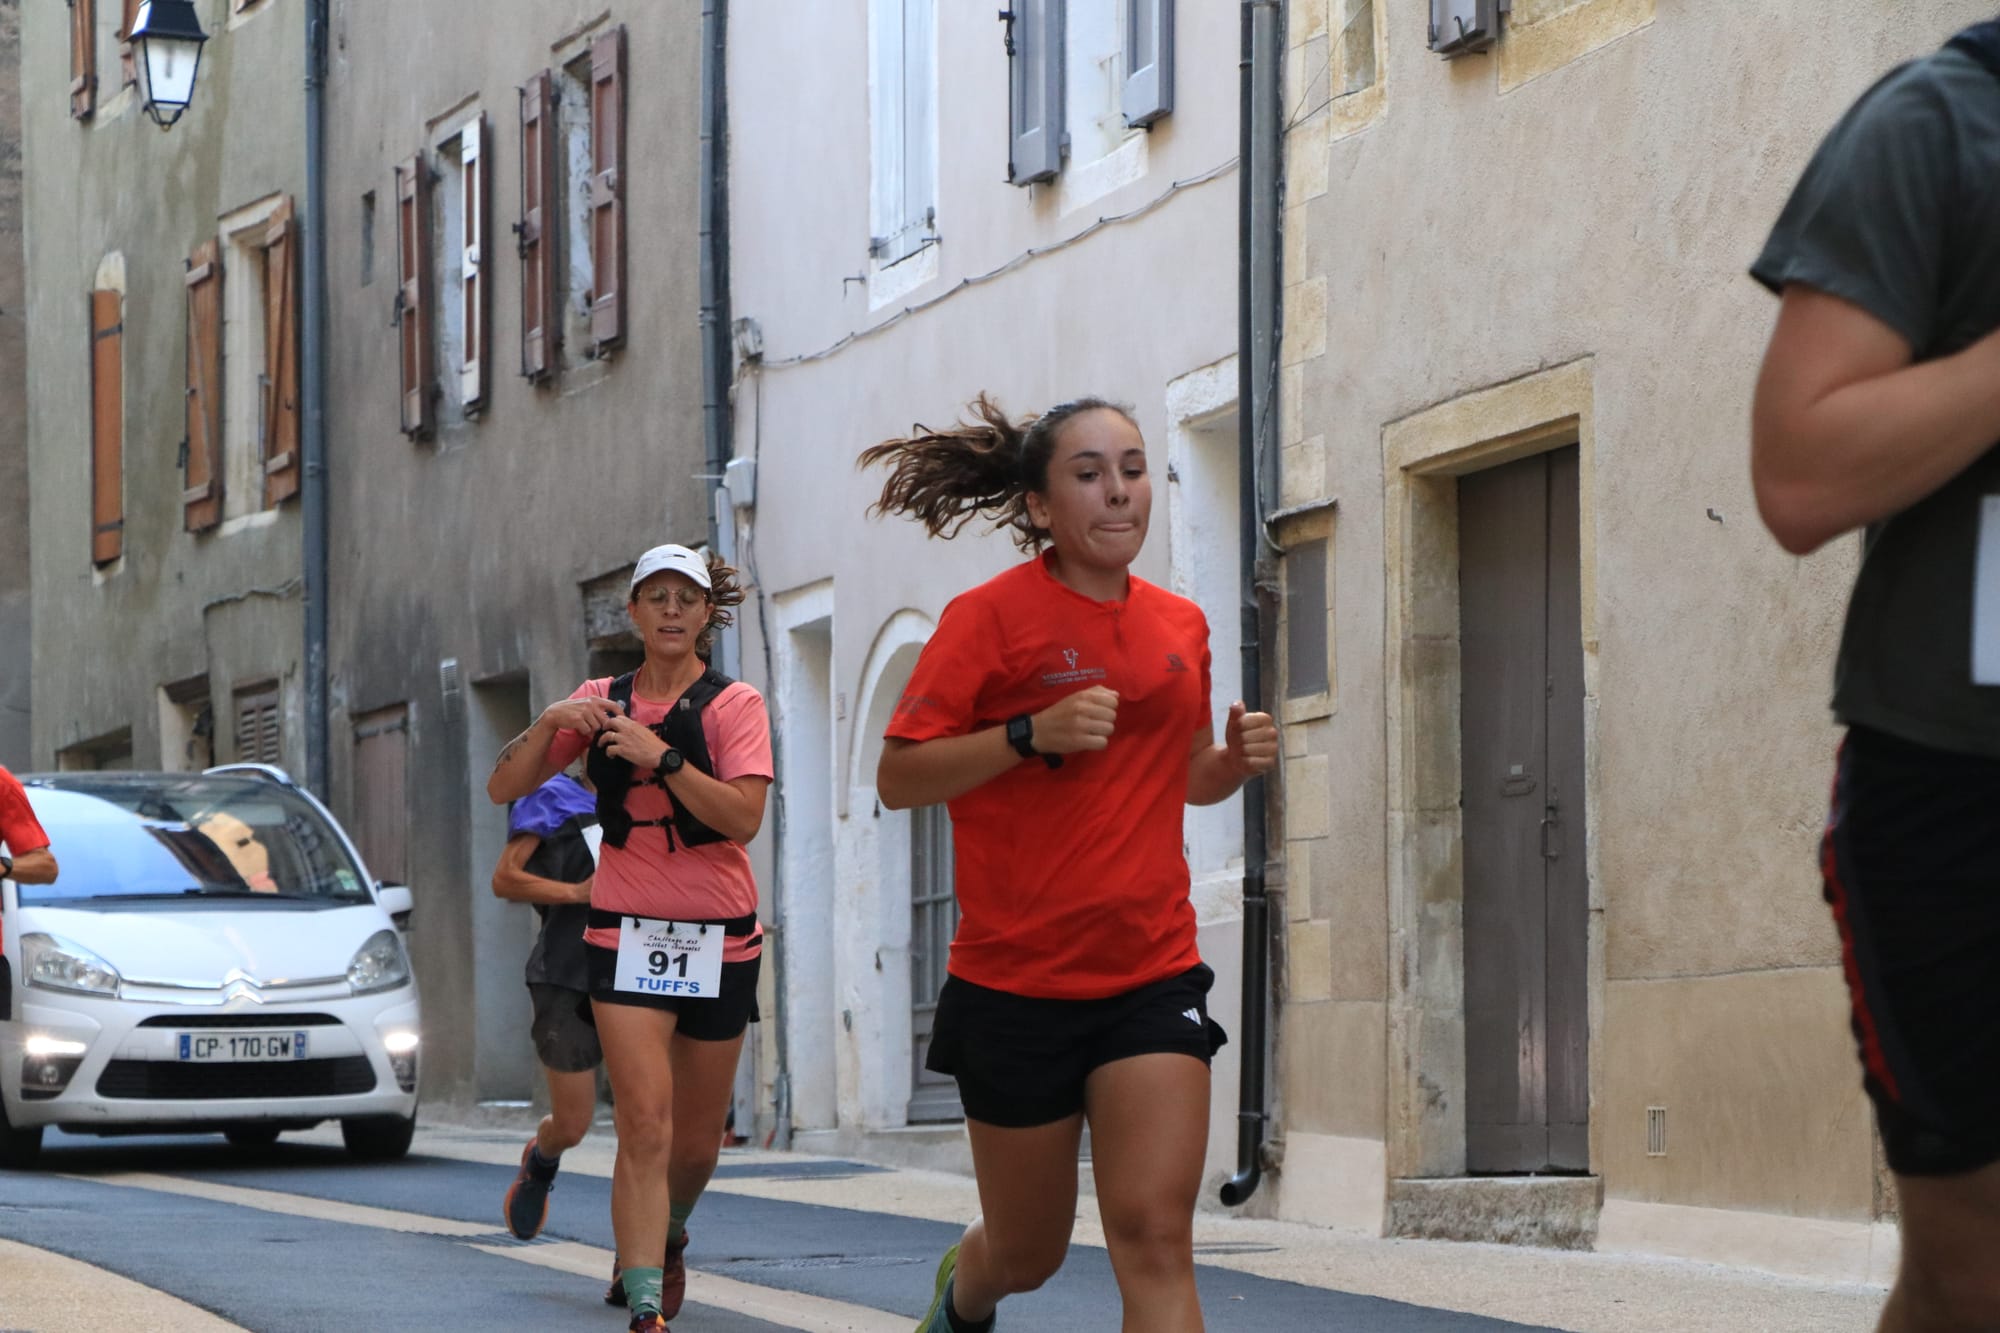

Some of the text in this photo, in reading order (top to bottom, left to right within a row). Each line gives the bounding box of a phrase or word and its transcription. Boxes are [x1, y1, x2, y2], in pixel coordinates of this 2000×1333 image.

[648, 935, 682, 945] Challenge
[648, 950, 688, 978] 91
[635, 976, 700, 993] TUFF'S
